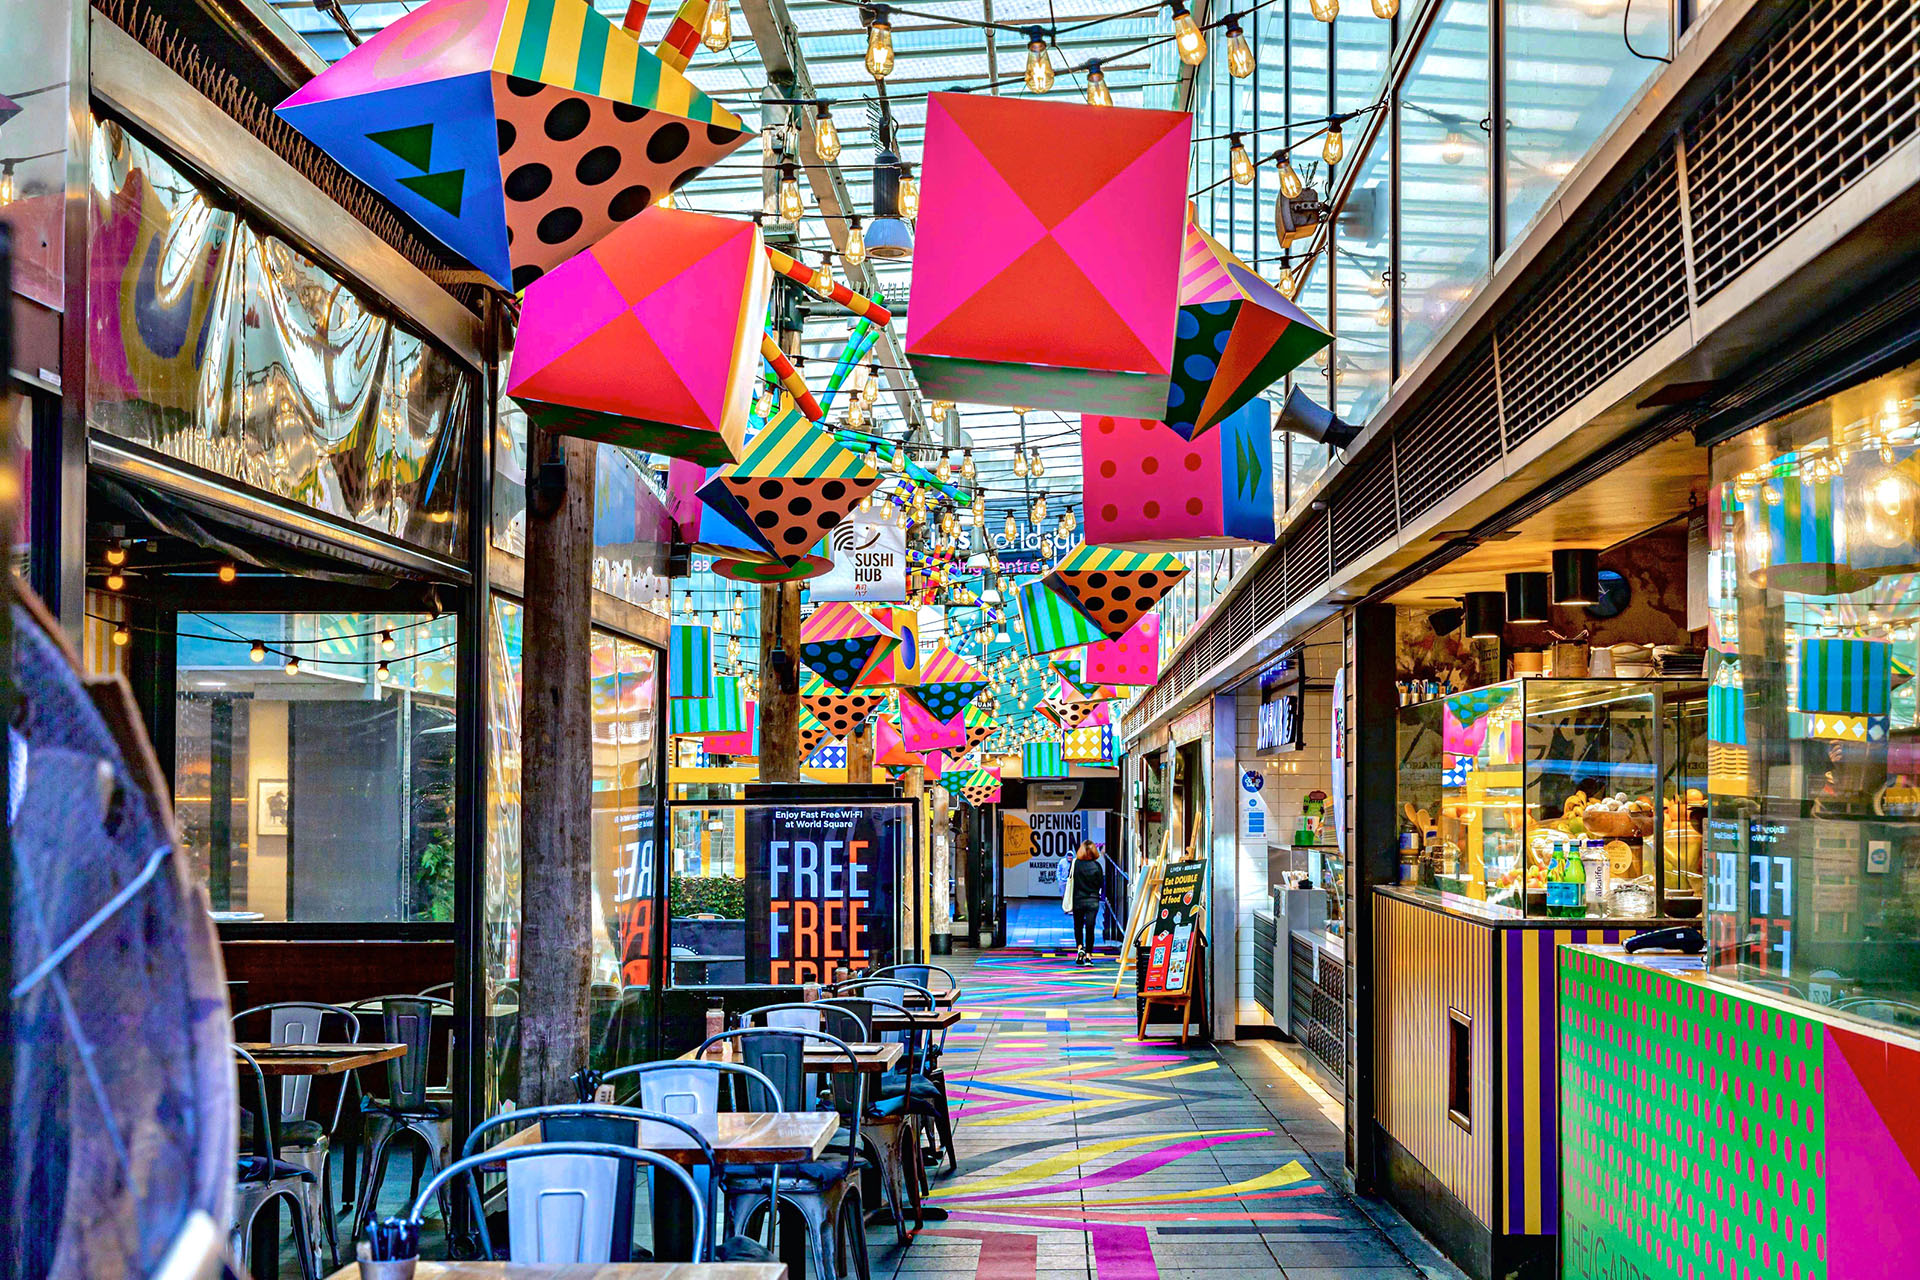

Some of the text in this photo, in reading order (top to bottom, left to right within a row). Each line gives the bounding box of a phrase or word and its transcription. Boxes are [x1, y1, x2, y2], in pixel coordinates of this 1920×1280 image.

[855, 553, 894, 567] SUSHI
[999, 558, 1040, 574] entre
[855, 568, 882, 582] HUB
[775, 811, 863, 820] Enjoy Fast Free Wi-Fi
[1029, 814, 1081, 830] OPENING
[823, 821, 853, 829] Square
[1029, 831, 1081, 857] SOON
[770, 840, 869, 898] FREE
[1029, 861, 1058, 869] MAXBRENNE
[1164, 873, 1198, 886] Eat DOUBLE
[1163, 884, 1195, 895] the amount
[1161, 894, 1181, 905] of food
[770, 901, 869, 958] FREE
